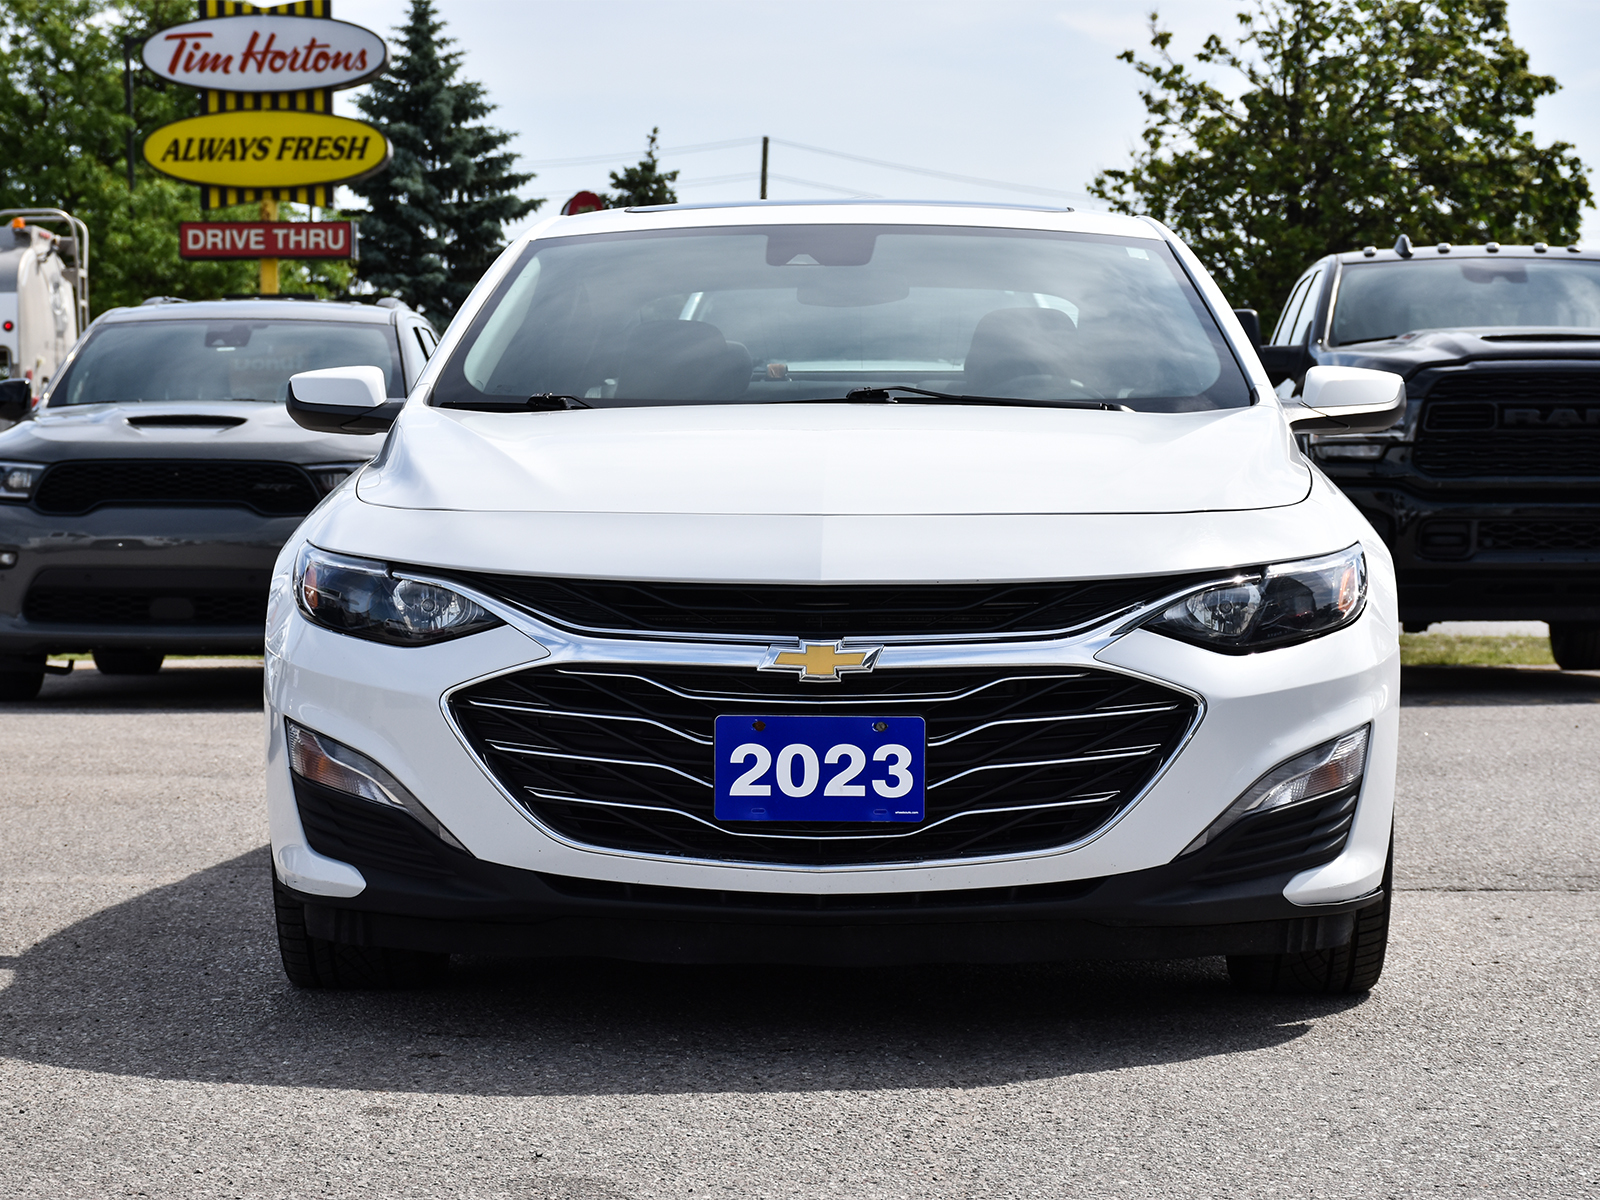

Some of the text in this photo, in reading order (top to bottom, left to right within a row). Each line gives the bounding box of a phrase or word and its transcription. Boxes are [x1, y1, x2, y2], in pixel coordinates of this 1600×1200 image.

[164, 30, 368, 75] Tim Hortons
[161, 135, 371, 162] ALWAYS FRESH
[187, 229, 345, 250] DRIVE THRU
[729, 743, 914, 798] 2023
